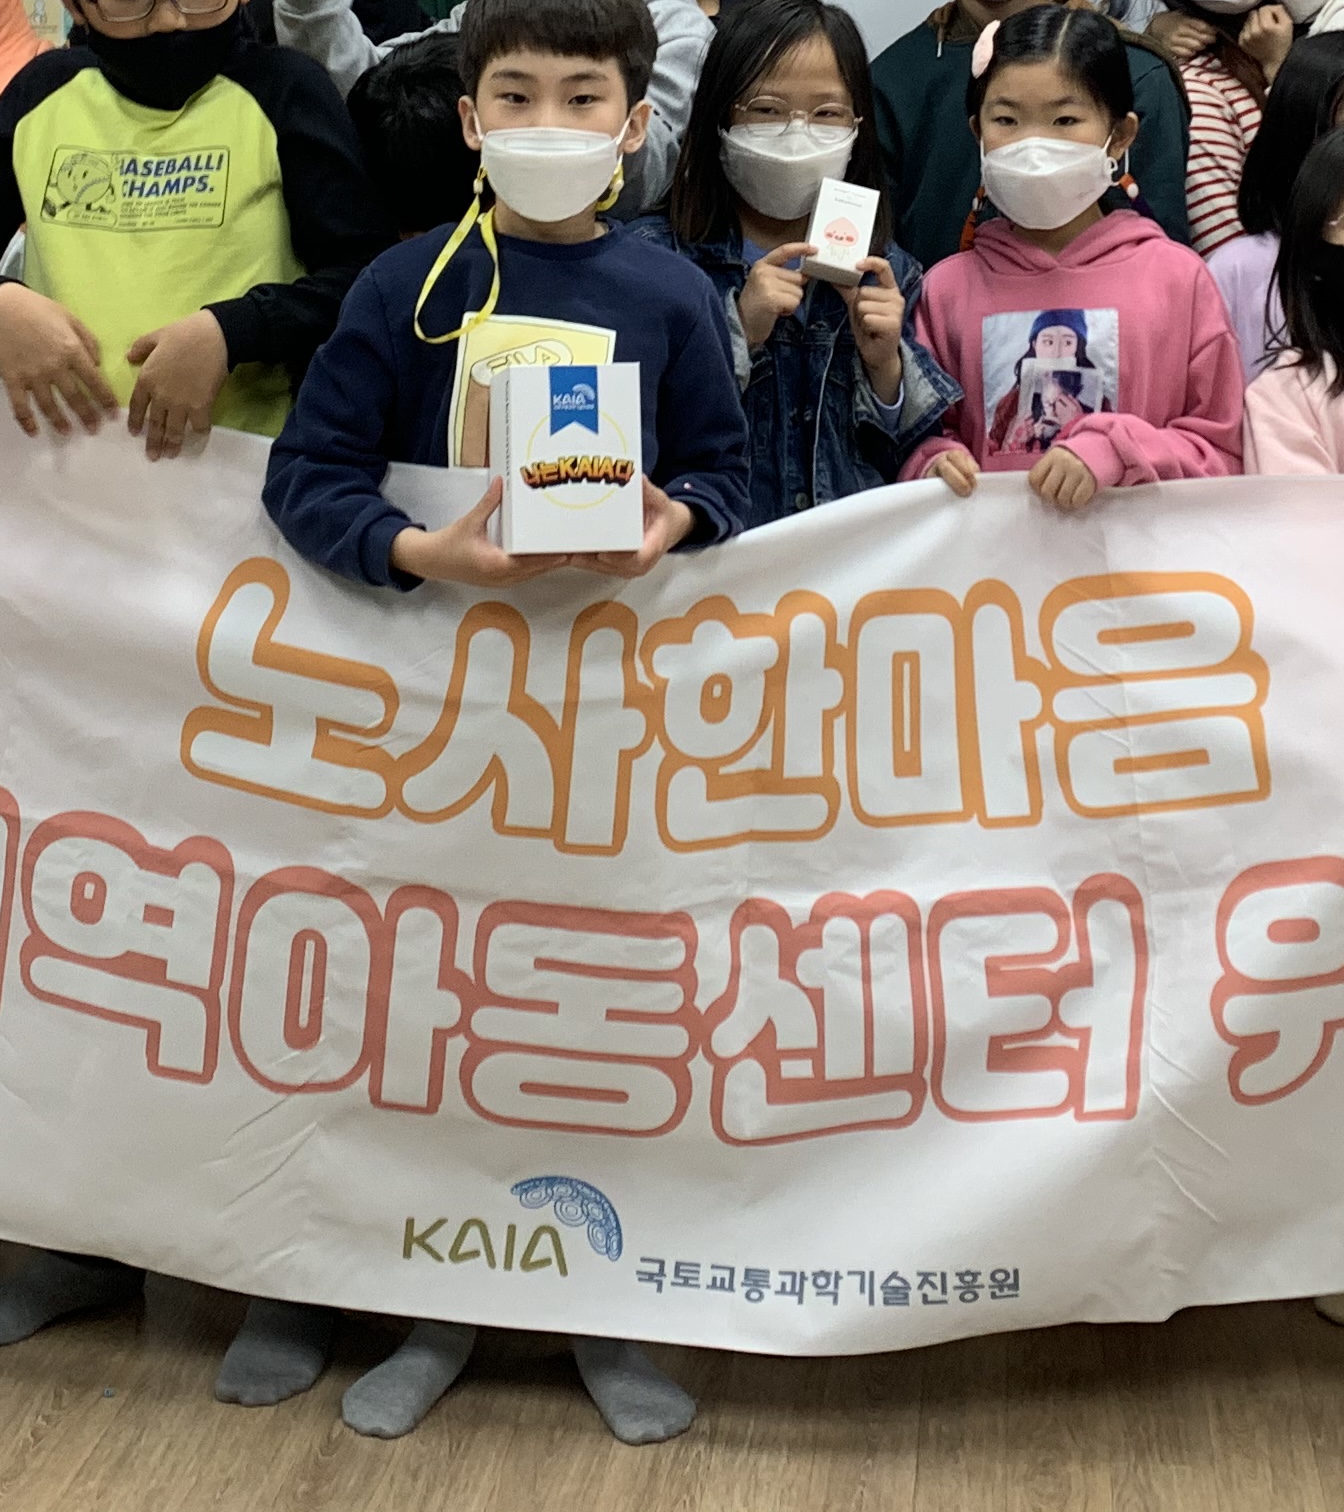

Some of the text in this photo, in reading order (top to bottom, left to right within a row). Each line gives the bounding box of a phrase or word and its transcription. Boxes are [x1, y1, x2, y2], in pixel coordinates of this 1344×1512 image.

[553, 392, 586, 406] KAIA
[181, 555, 1272, 858] 노사한마음
[403, 1217, 569, 1277] KAIA
[636, 1257, 1021, 1306] 국토교통과학기술진흥원
